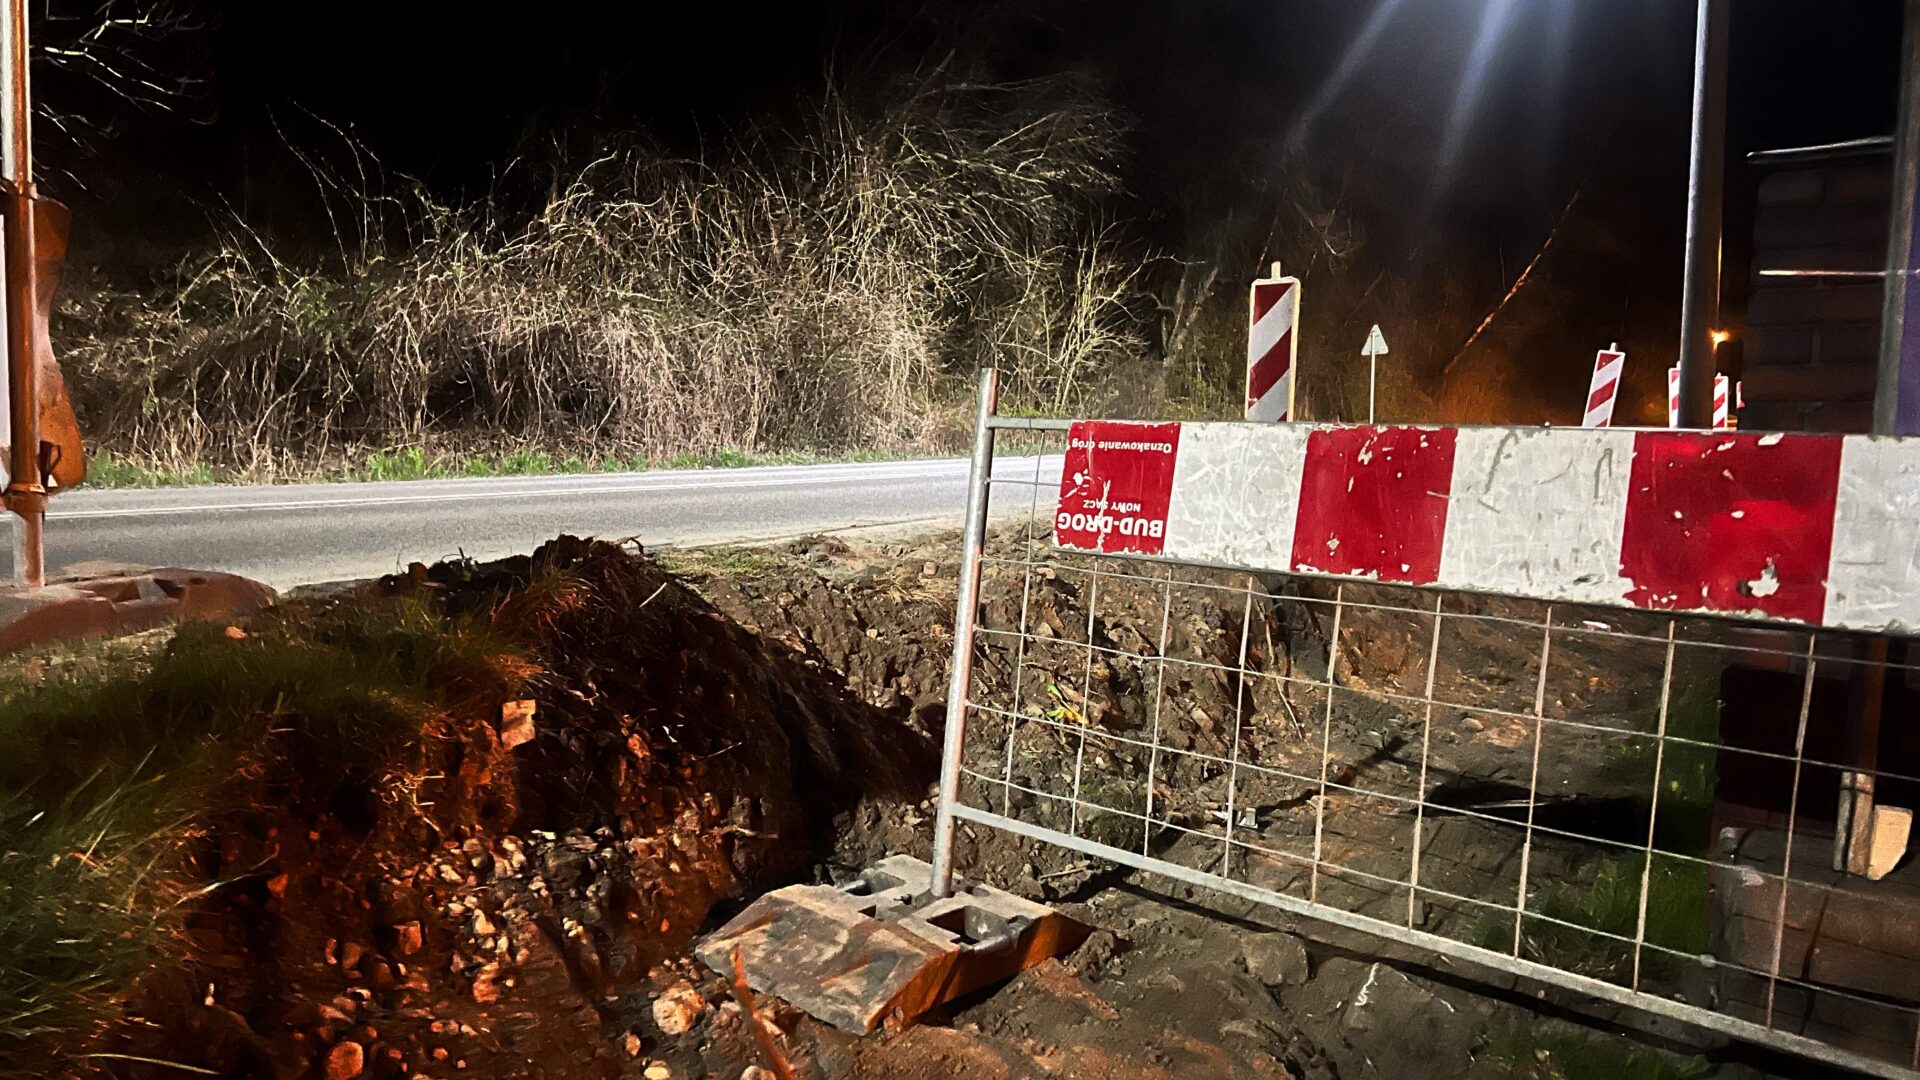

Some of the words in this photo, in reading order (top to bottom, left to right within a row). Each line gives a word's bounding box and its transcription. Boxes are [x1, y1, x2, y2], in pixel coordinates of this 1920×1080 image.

[1098, 441, 1172, 453] Oznakowanie
[1111, 502, 1141, 513] NOWY
[1058, 512, 1163, 538] BUD-DROG
